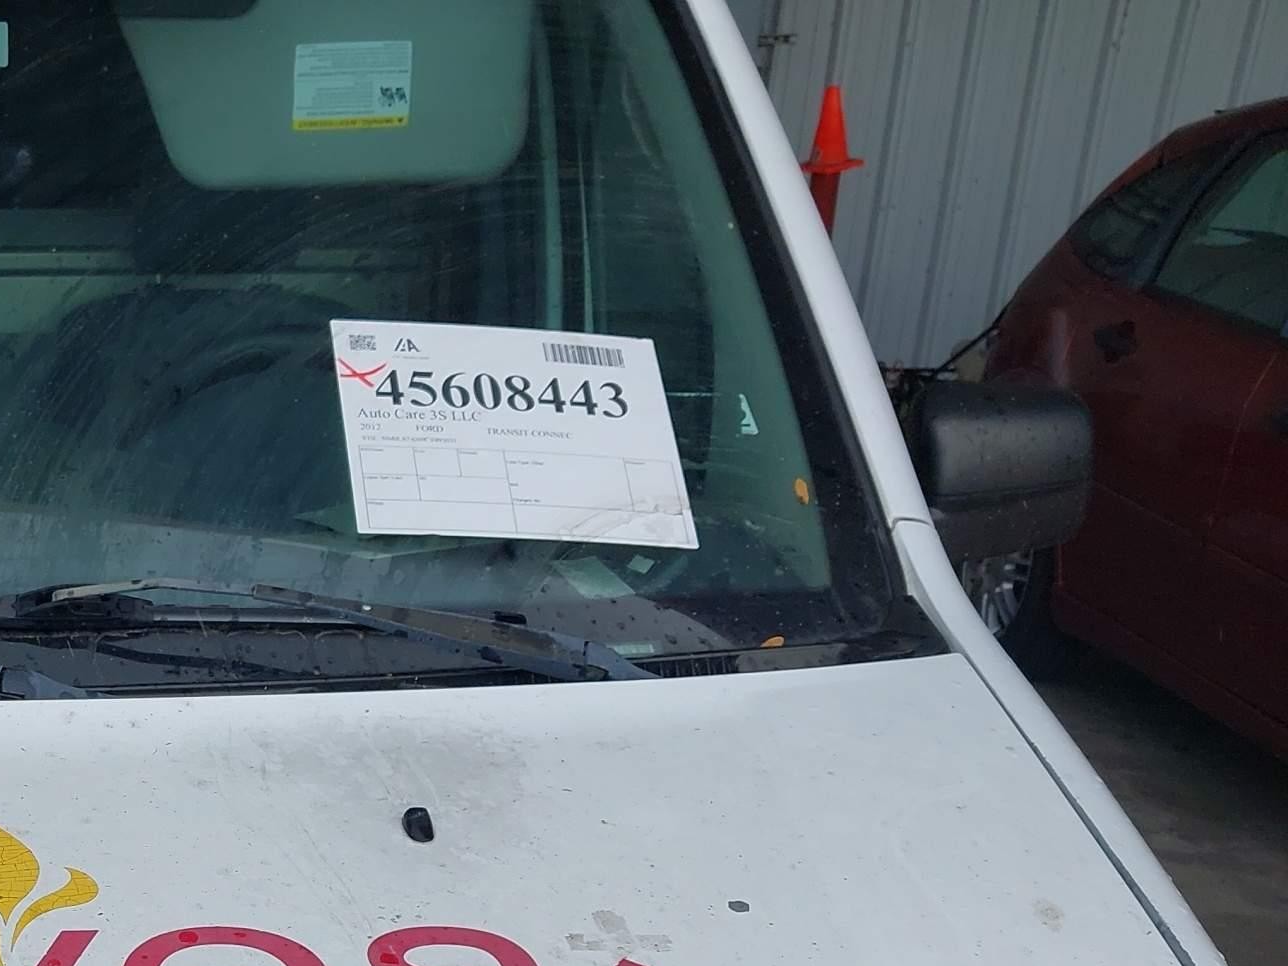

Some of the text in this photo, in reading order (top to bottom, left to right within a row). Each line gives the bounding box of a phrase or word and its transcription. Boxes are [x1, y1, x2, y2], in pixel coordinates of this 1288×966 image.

[375, 369, 629, 418] 45608443
[358, 407, 481, 422] Auto Care 3S LLC
[360, 423, 573, 439] 2012 FORD TRANSIT CONNEC
